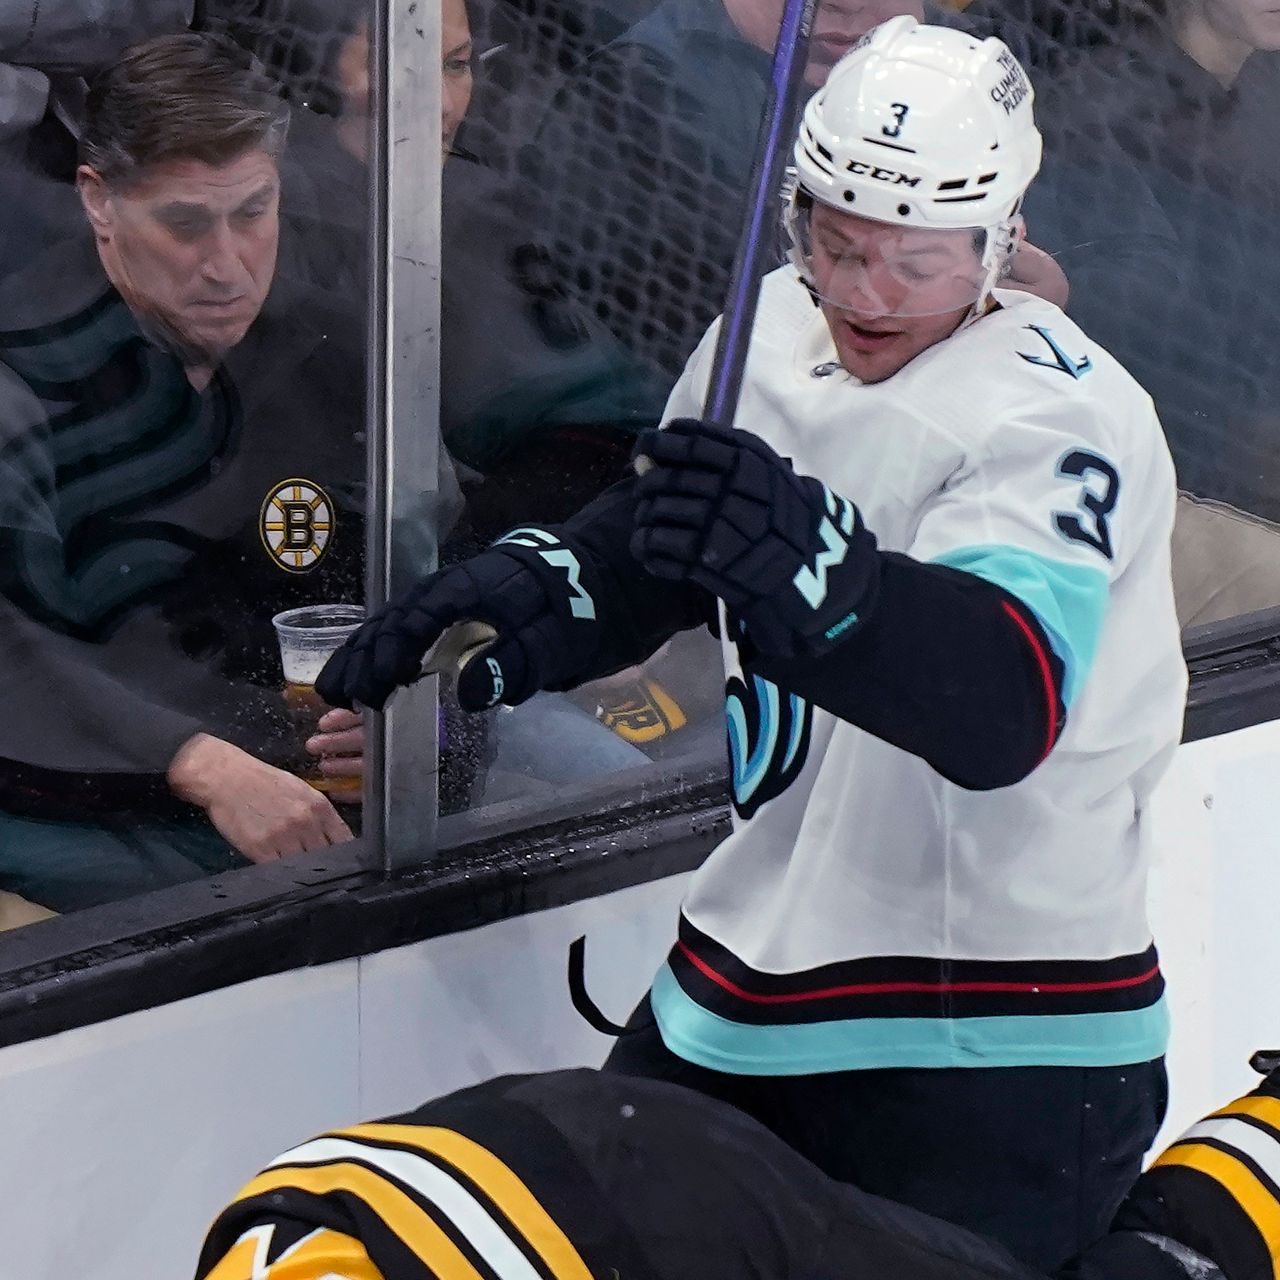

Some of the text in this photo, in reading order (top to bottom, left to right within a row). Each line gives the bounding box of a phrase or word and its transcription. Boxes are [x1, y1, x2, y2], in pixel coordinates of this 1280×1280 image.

[882, 102, 910, 138] 3
[846, 158, 922, 189] CCM
[1051, 446, 1121, 562] 3
